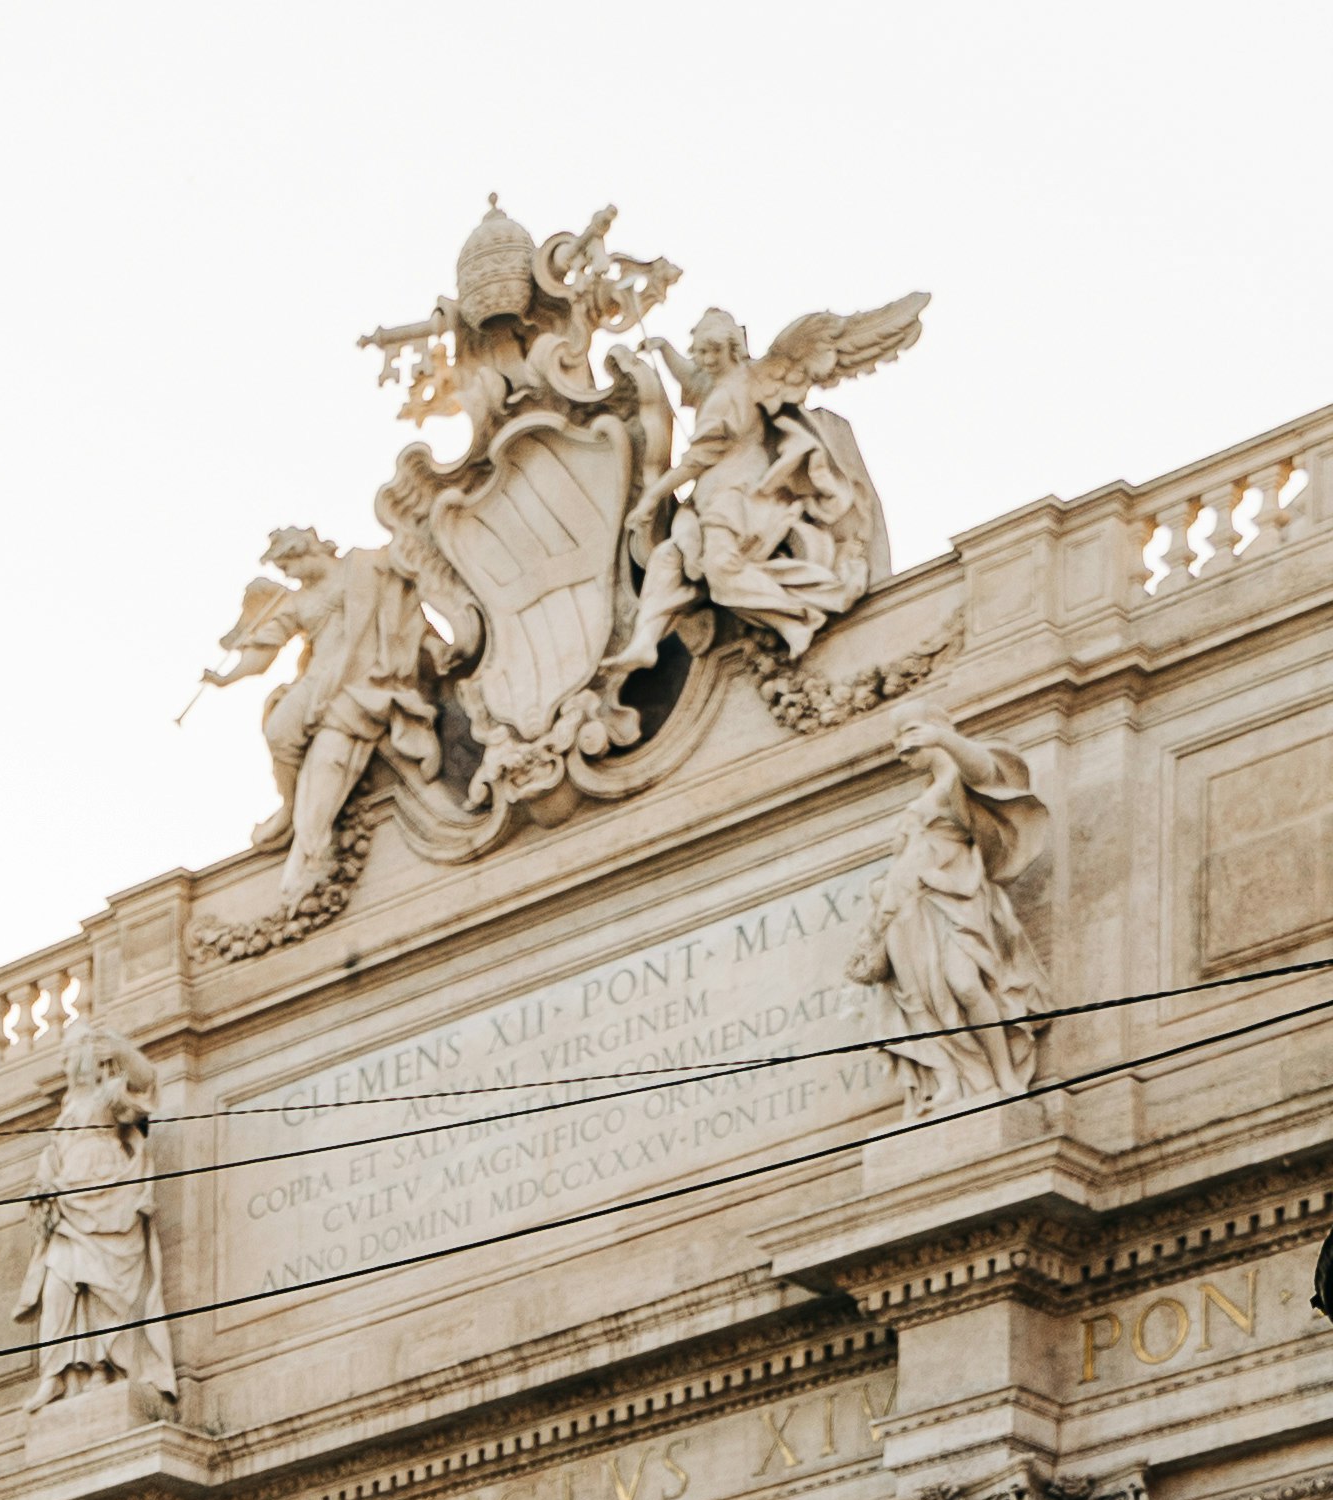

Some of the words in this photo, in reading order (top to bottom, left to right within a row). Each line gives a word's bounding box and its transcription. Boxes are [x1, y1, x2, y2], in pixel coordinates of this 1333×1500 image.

[282, 1030, 463, 1127] CLEMENS
[540, 990, 710, 1073] VIRGINEM
[247, 1171, 334, 1221] COPIA
[348, 1150, 383, 1187] ET
[322, 1177, 422, 1233] CVLTV
[442, 1106, 627, 1194] MAGNIFICO
[259, 1244, 347, 1294] ANNO
[358, 1200, 473, 1262] DOMINI
